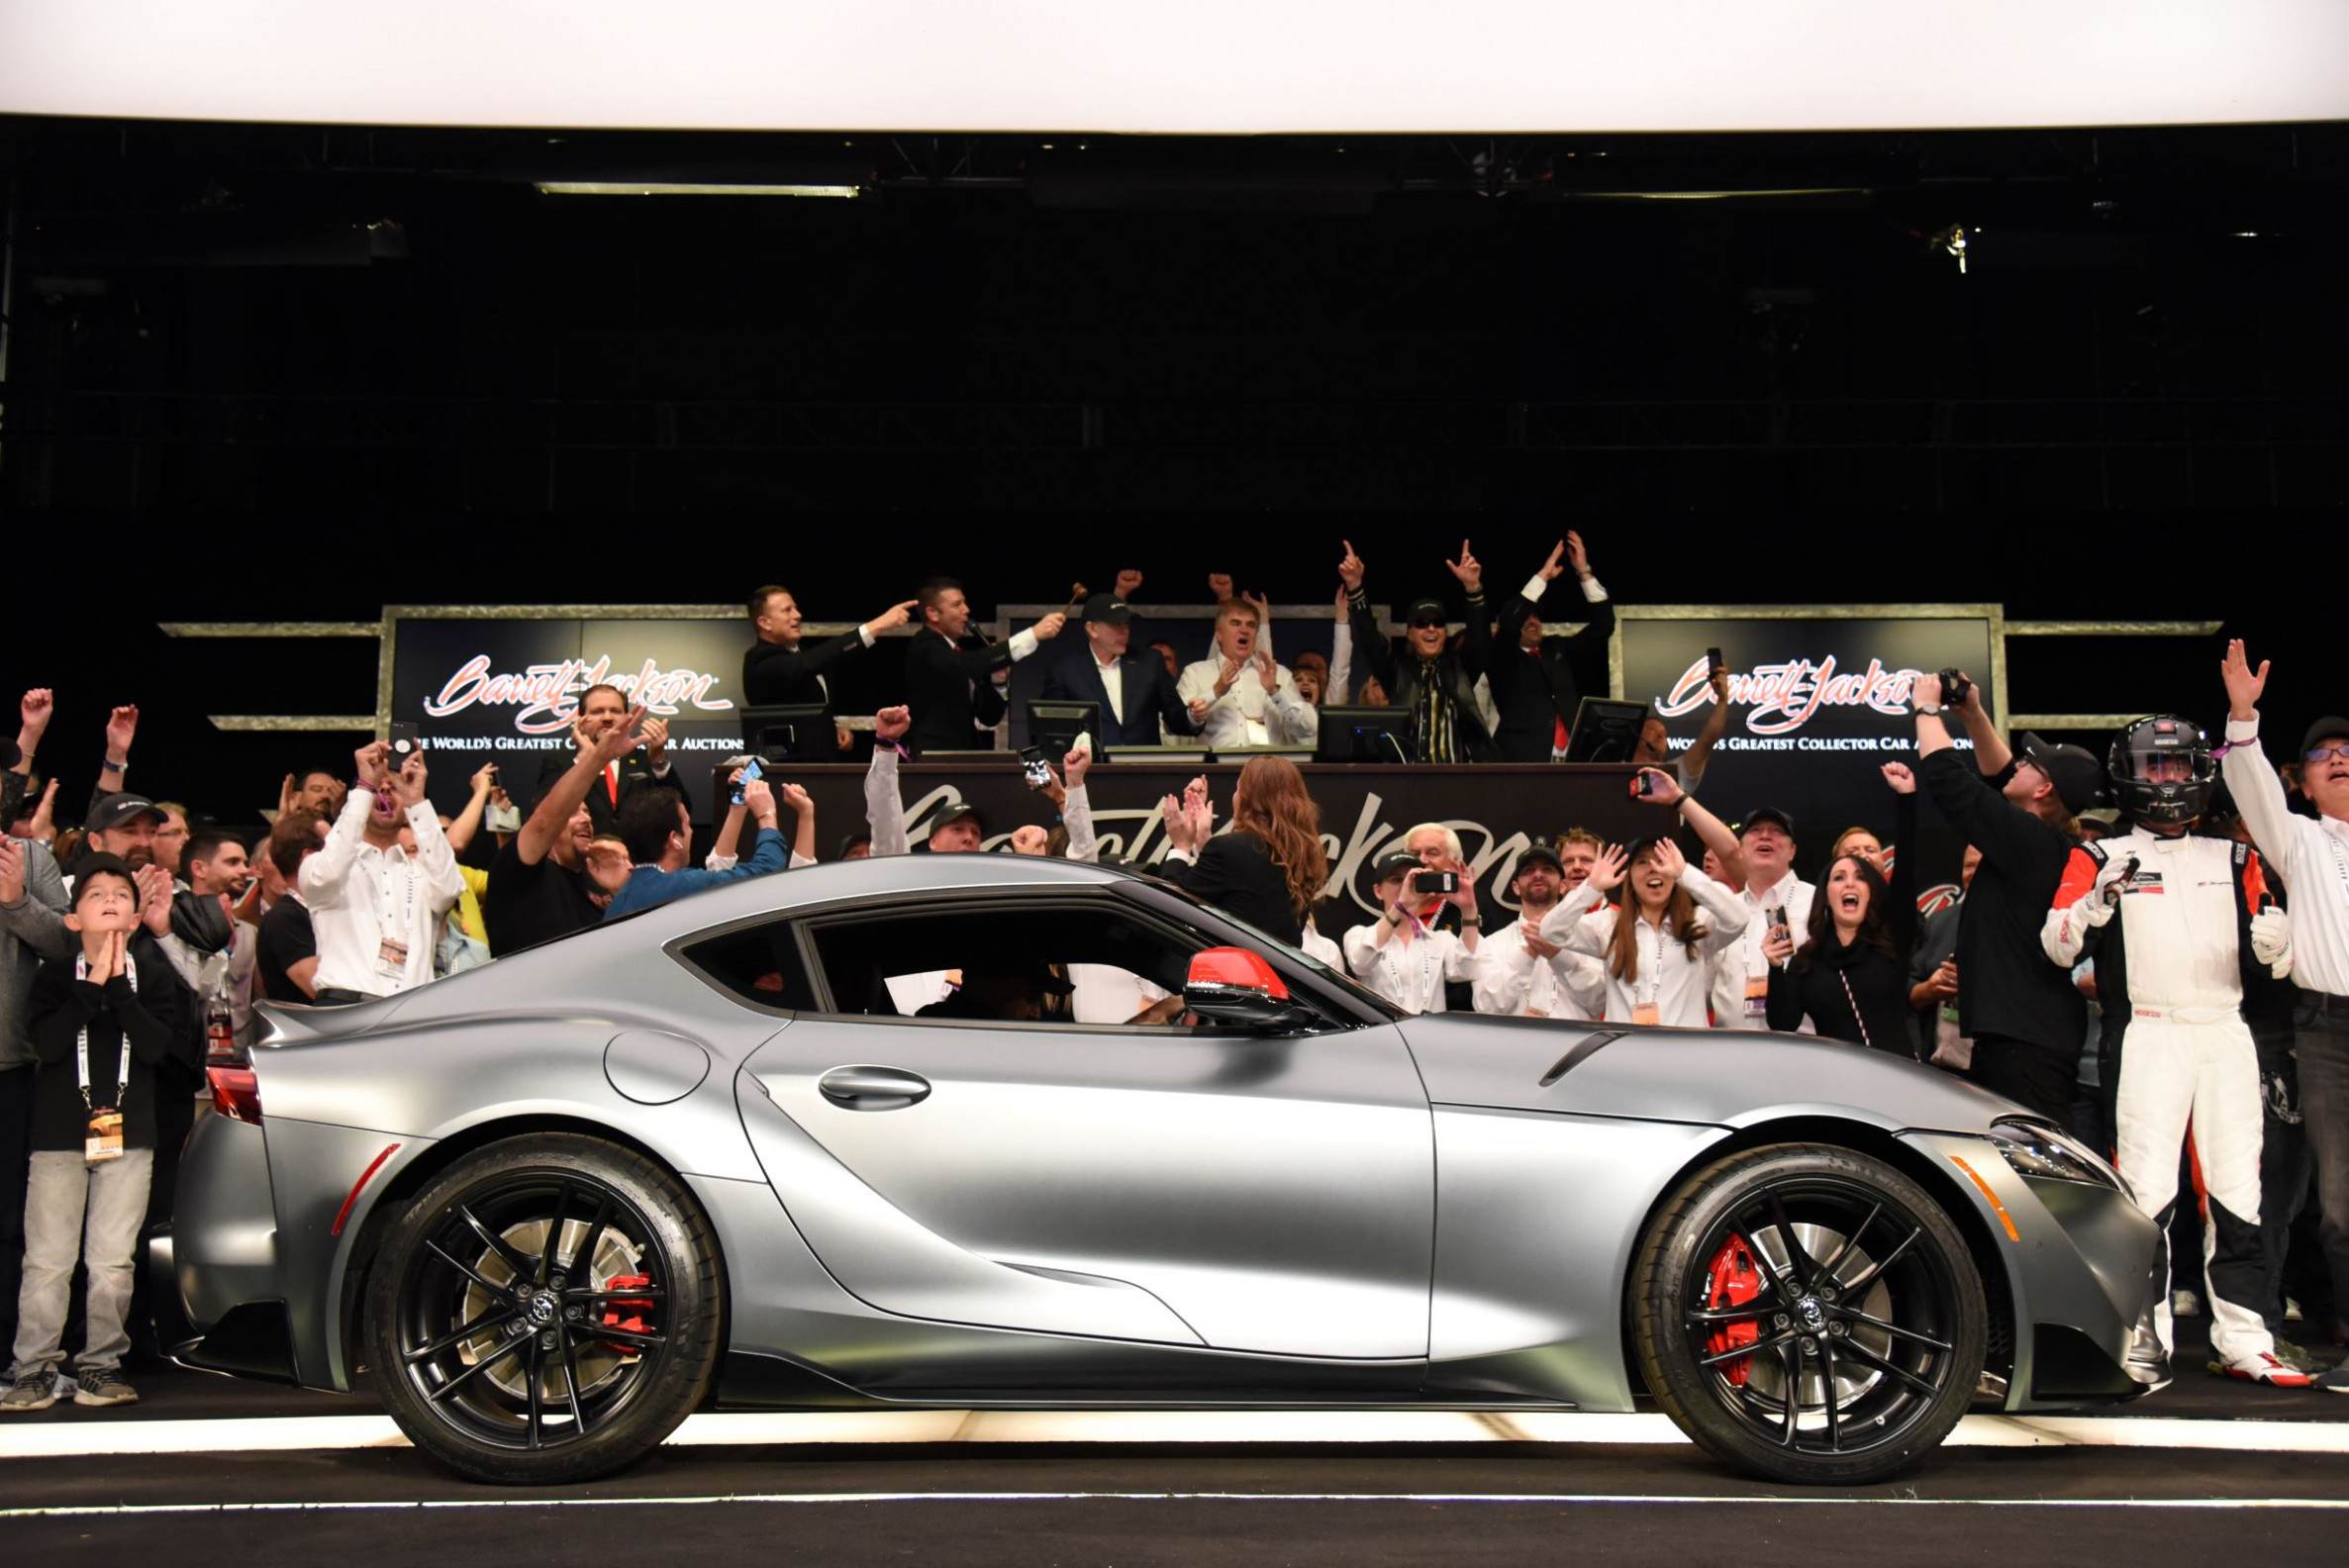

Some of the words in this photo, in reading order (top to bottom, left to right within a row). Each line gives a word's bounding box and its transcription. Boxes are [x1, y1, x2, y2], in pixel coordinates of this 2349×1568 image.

[1655, 654, 1949, 735] Brrett-Jackso
[433, 736, 492, 750] WORLD'S
[495, 736, 562, 750] GREATEST
[1727, 736, 1796, 750] GREATEST
[1797, 736, 1879, 750] COLLECTOR
[1880, 736, 1909, 750] CAR
